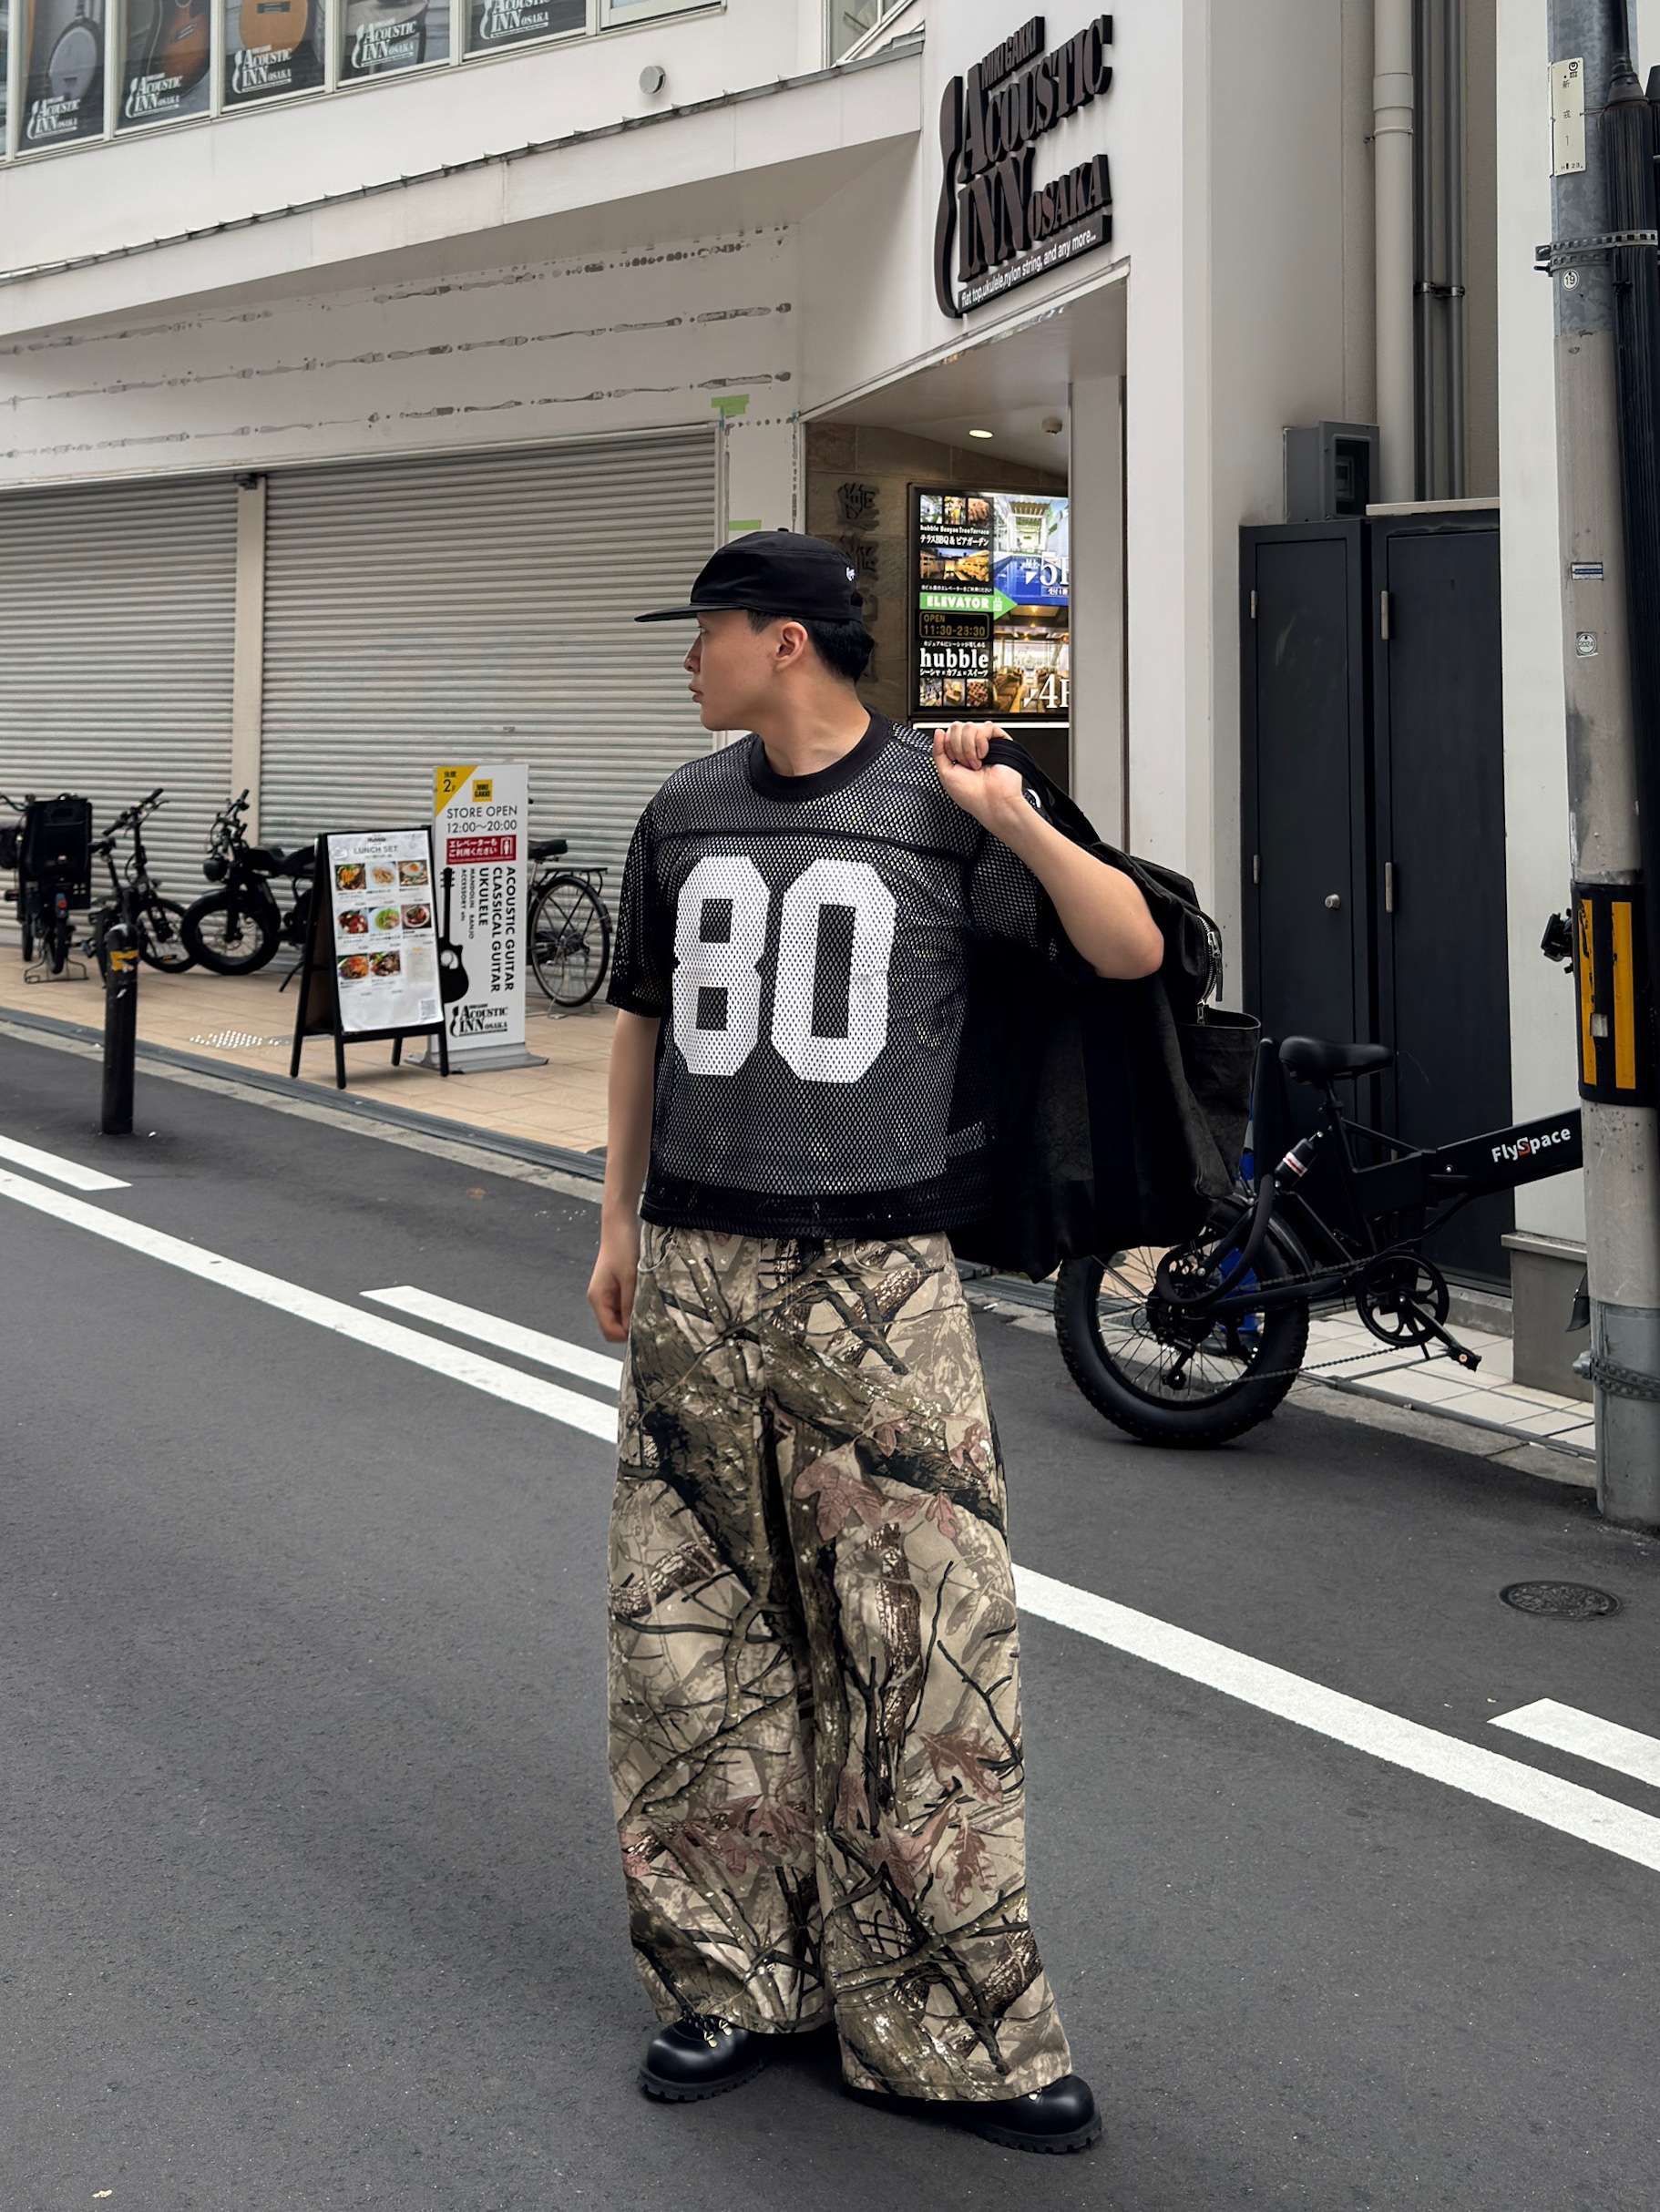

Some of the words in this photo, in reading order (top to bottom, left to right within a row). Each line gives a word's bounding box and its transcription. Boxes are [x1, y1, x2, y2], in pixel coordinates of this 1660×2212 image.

[493, 0, 549, 14] ACOUS
[492, 9, 522, 32] INN
[364, 20, 416, 45] ACOUSTIC
[242, 48, 292, 69] ACOUSTIC
[362, 39, 390, 61] INN
[137, 76, 183, 96] ACOUSTIC
[242, 66, 269, 87] INN
[134, 92, 159, 111] INN
[957, 14, 1112, 184] ACOUSTIC
[36, 115, 59, 134] INN
[958, 147, 1036, 282] INN
[1027, 154, 1112, 241] OSAKA
[961, 290, 972, 308] flat
[1022, 254, 1042, 276] string,
[1043, 244, 1057, 265] and
[1058, 241, 1071, 258] any
[1071, 230, 1096, 251] more...
[1565, 275, 1575, 284] 19
[927, 595, 989, 609] ELEVATOR
[924, 614, 946, 622] OPEN
[924, 625, 986, 637] 11:30-23:30
[919, 648, 989, 668] hubble
[446, 807, 483, 819] STORE
[486, 805, 517, 817] OPEN
[478, 867, 489, 926] UKULELE
[492, 866, 503, 938] CLASSICAL
[505, 866, 516, 935] ACOUSTIC
[490, 941, 501, 993] GUITAR
[504, 939, 515, 991] GUITAR
[671, 855, 897, 1084] 80
[460, 1005, 508, 1020] ACOUSTIC
[460, 1019, 484, 1032] INN
[1491, 1128, 1571, 1162] FlySpace
